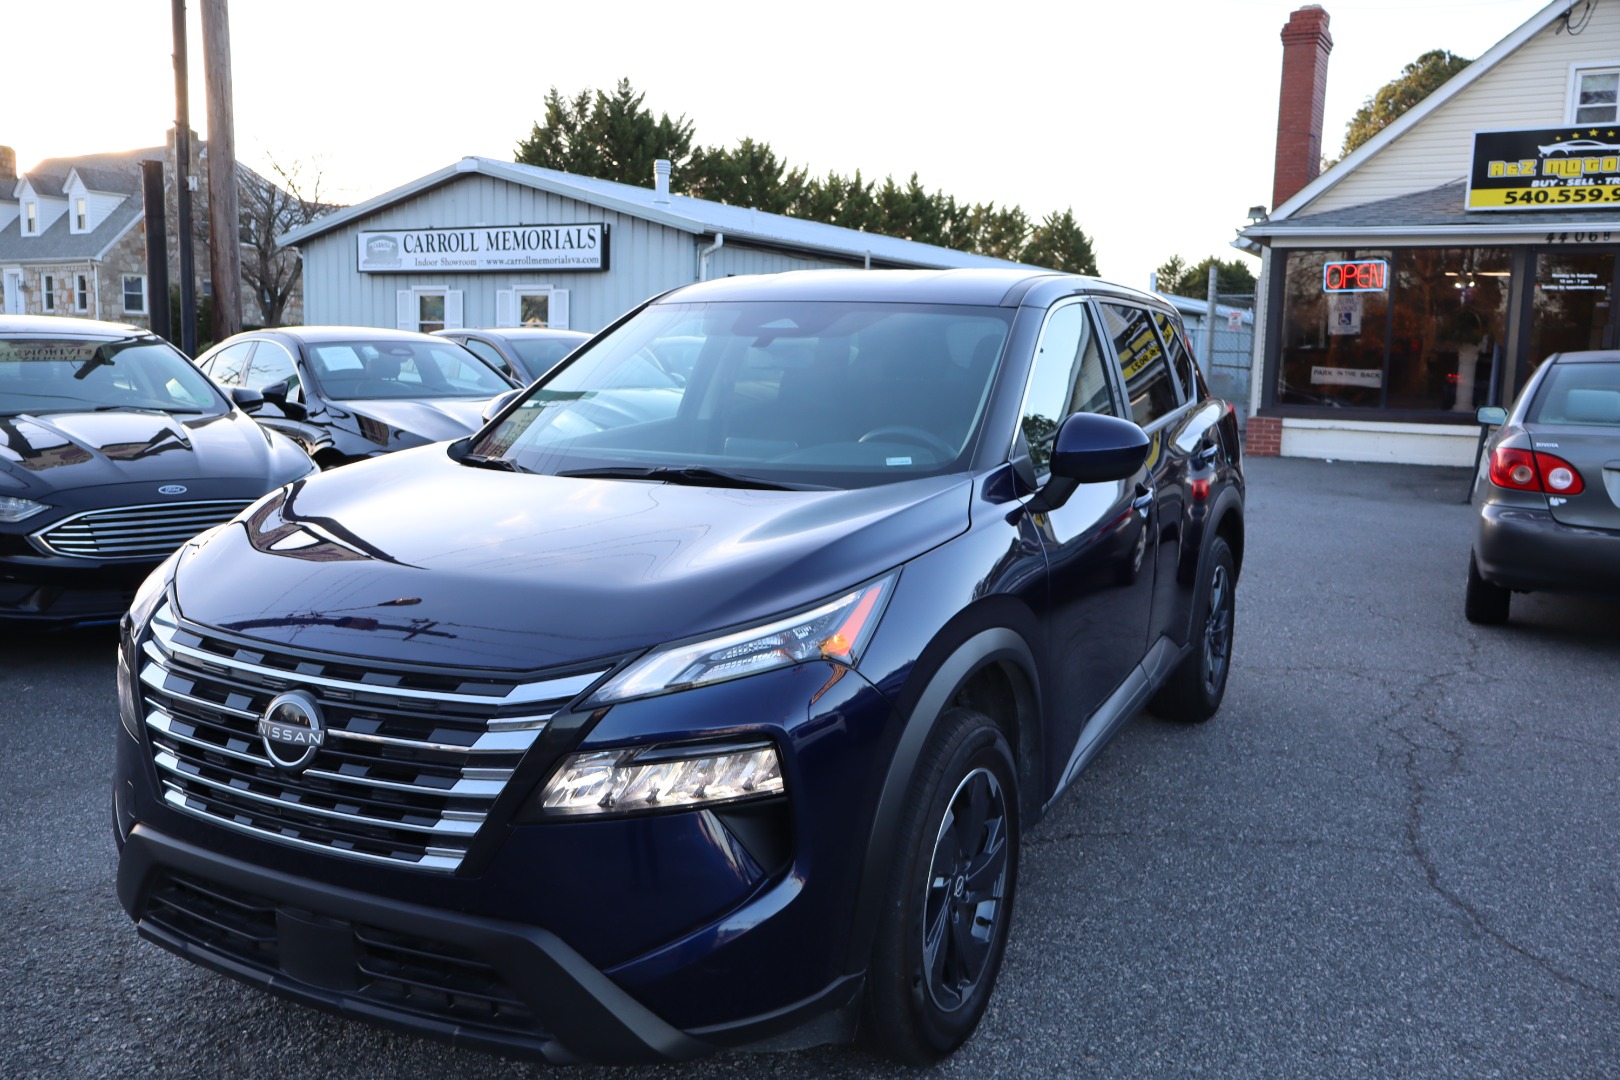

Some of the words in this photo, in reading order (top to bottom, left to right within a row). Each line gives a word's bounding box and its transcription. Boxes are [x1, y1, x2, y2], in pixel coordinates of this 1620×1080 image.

[1531, 179, 1558, 188] BUY
[1566, 178, 1595, 186] SELL
[403, 232, 480, 254] CARROLL
[486, 228, 597, 252] MEMORIALS
[415, 257, 438, 267] Indoor
[440, 257, 477, 267] Showroom
[486, 254, 600, 266] www.carrollmemorialsva.com
[1326, 263, 1385, 289] OPEN
[1313, 369, 1333, 377] PARK
[1360, 371, 1381, 379] BACK
[259, 722, 322, 744] NISSAN
